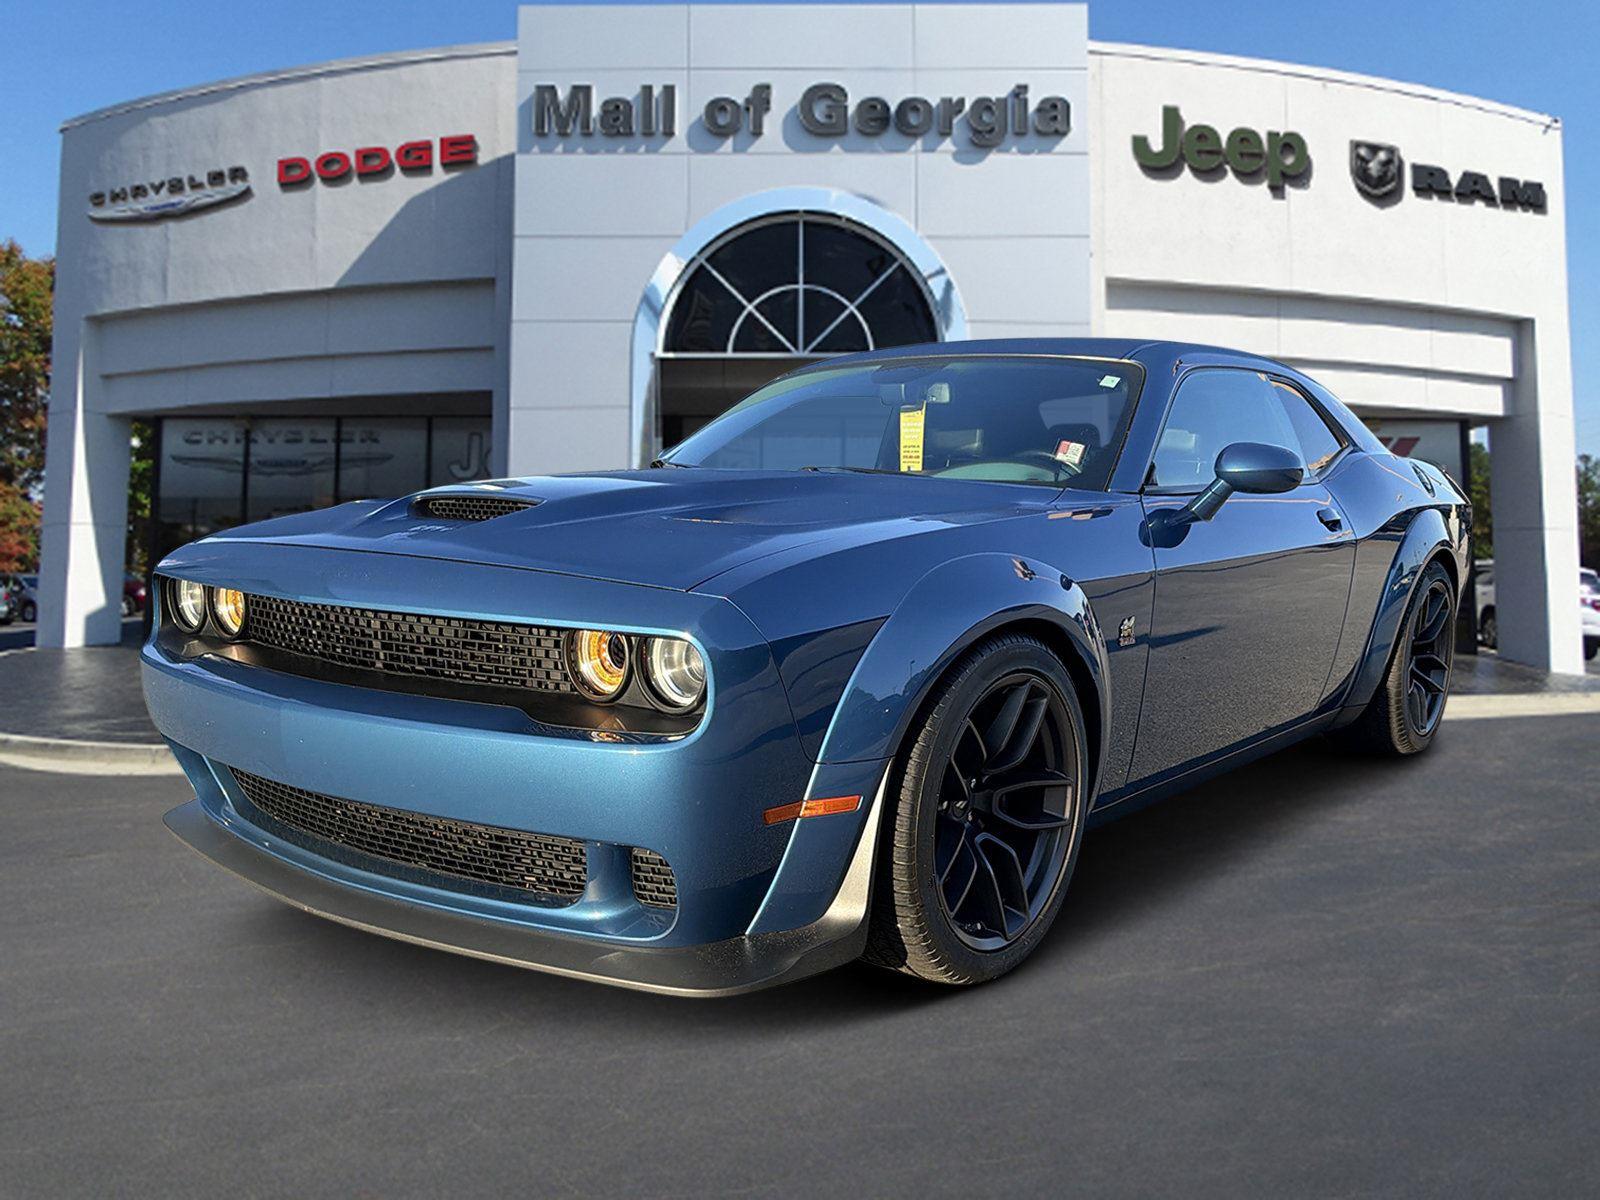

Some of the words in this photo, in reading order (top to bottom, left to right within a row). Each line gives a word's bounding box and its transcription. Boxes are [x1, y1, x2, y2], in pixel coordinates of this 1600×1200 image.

[532, 84, 676, 137] Mall
[703, 83, 772, 137] of
[799, 82, 1072, 148] Georgia
[277, 134, 476, 187] DODGE
[1132, 105, 1310, 188] Jeep
[90, 166, 248, 206] CHRYSLER
[1411, 163, 1547, 214] RAM
